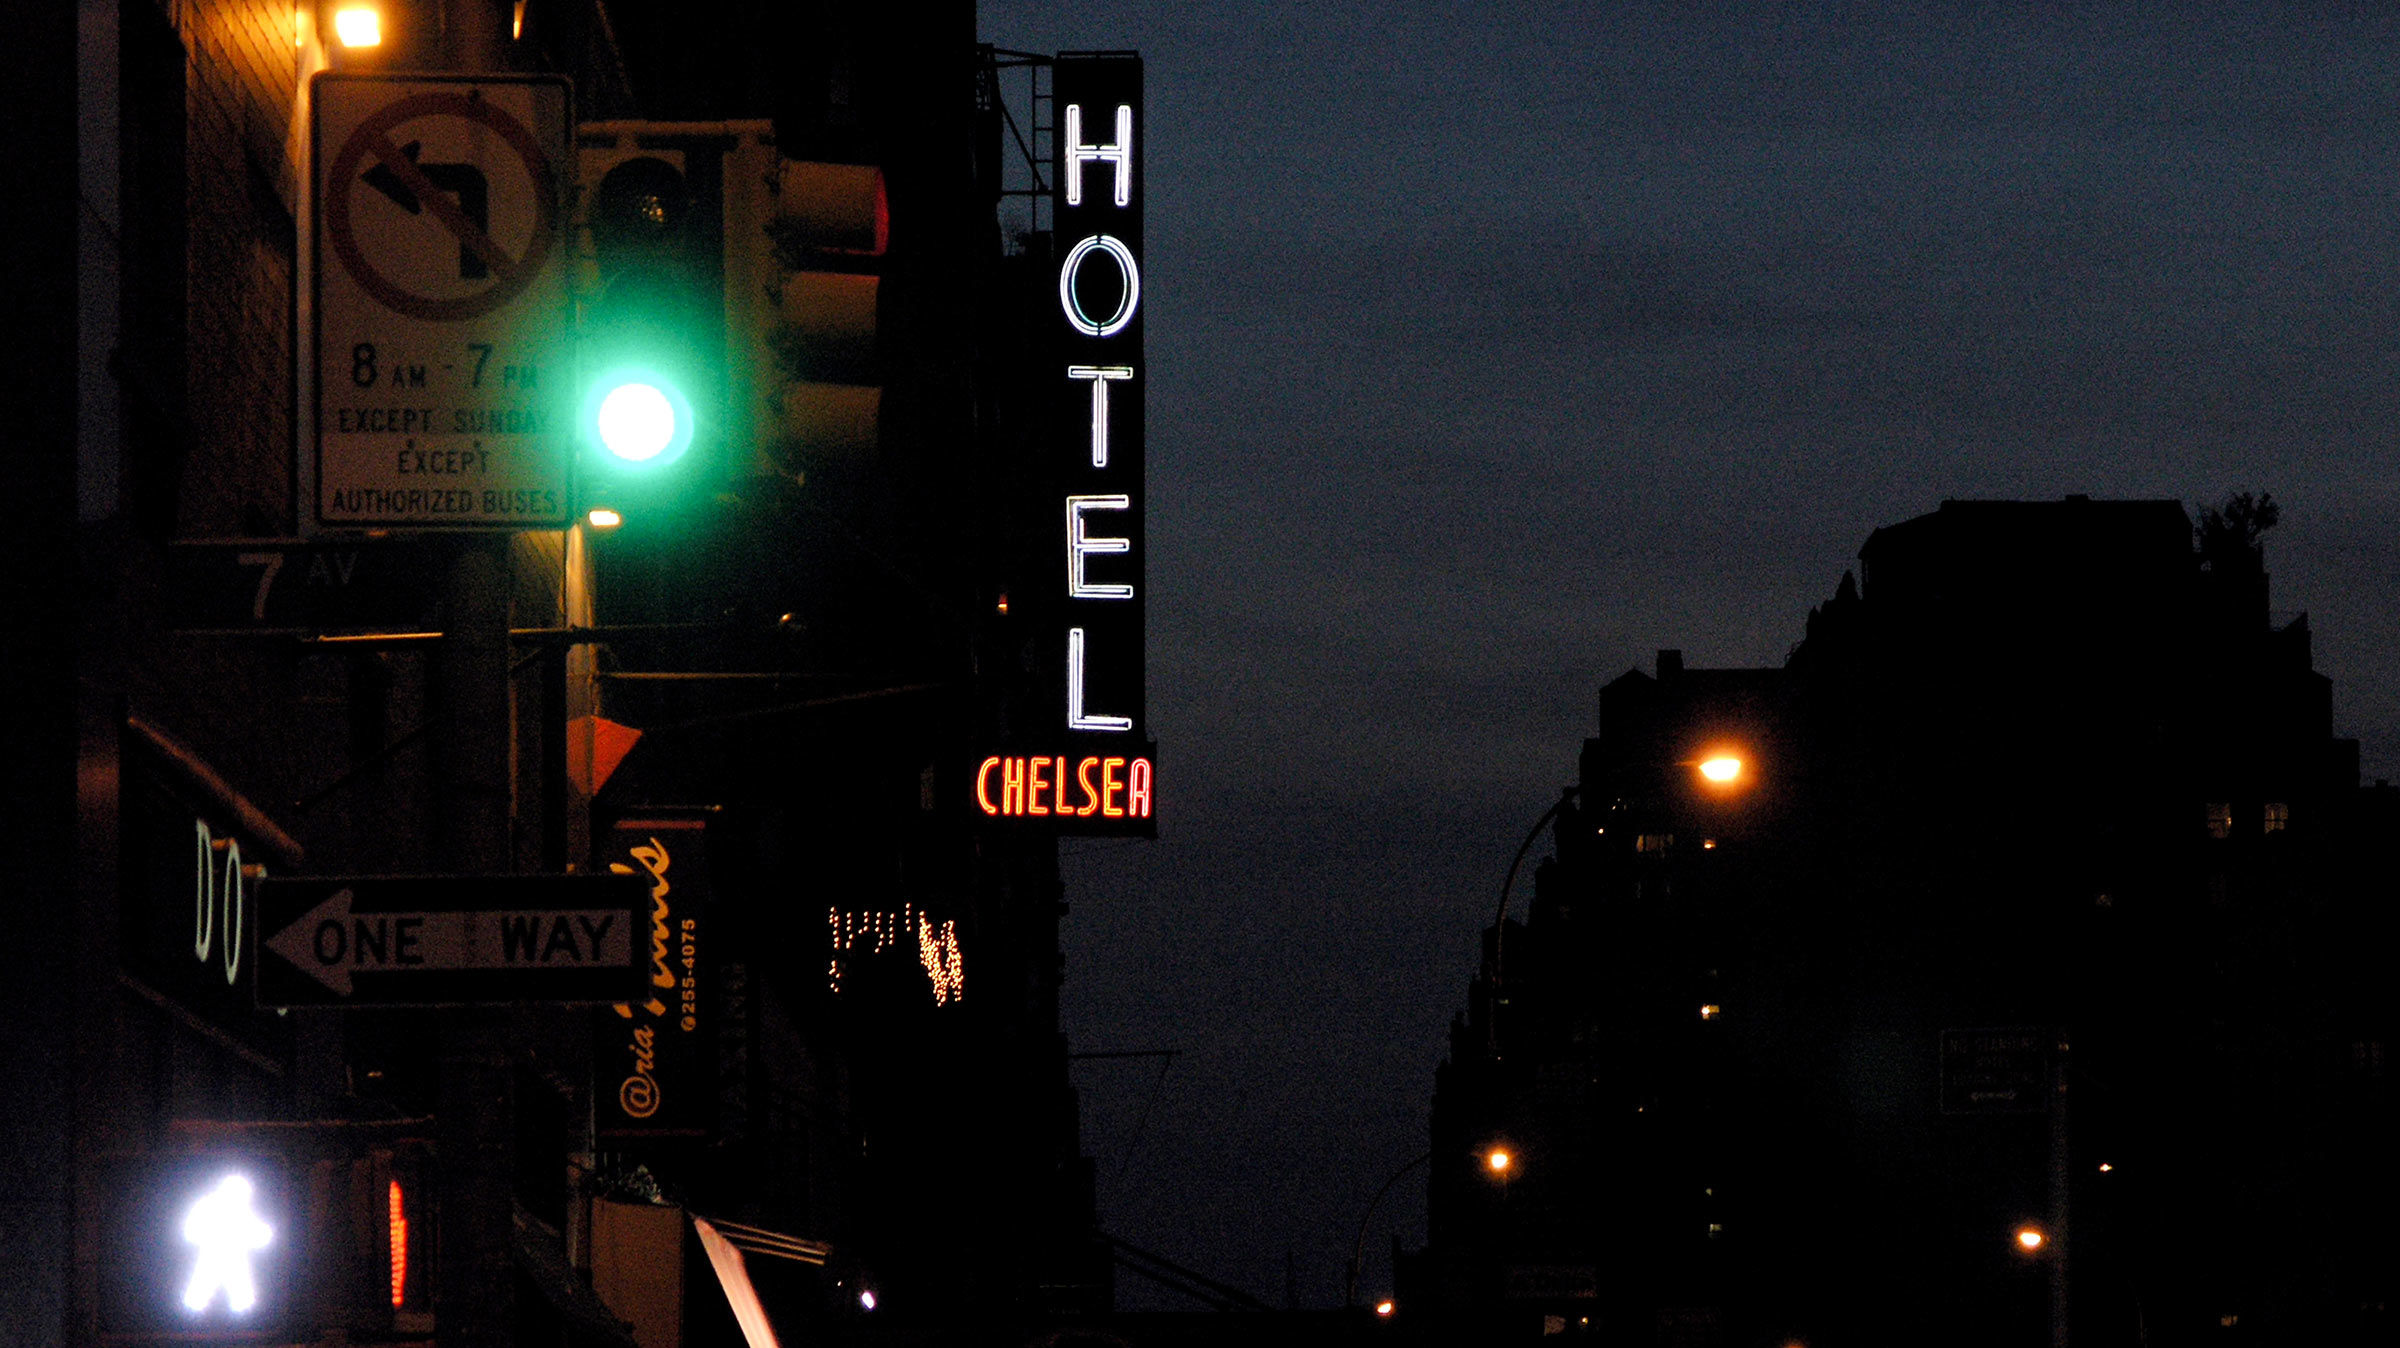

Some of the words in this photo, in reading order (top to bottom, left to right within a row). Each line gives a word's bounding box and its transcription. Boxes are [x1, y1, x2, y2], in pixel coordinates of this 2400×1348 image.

[353, 343, 377, 387] 8
[391, 366, 426, 388] AM
[469, 343, 493, 387] 7
[503, 365, 538, 389] PM
[338, 408, 433, 433] EXCEPT
[1060, 104, 1140, 731] HOTEL
[397, 450, 490, 475] EXCEPT
[331, 489, 473, 513] AUTHORIZED
[482, 490, 556, 514] BUSES
[236, 552, 284, 620] 7
[307, 551, 358, 586] AV
[977, 755, 1150, 818] CHELSEA
[314, 918, 425, 966] ONE
[501, 915, 614, 962] WAY
[680, 918, 697, 1014] 255-4075
